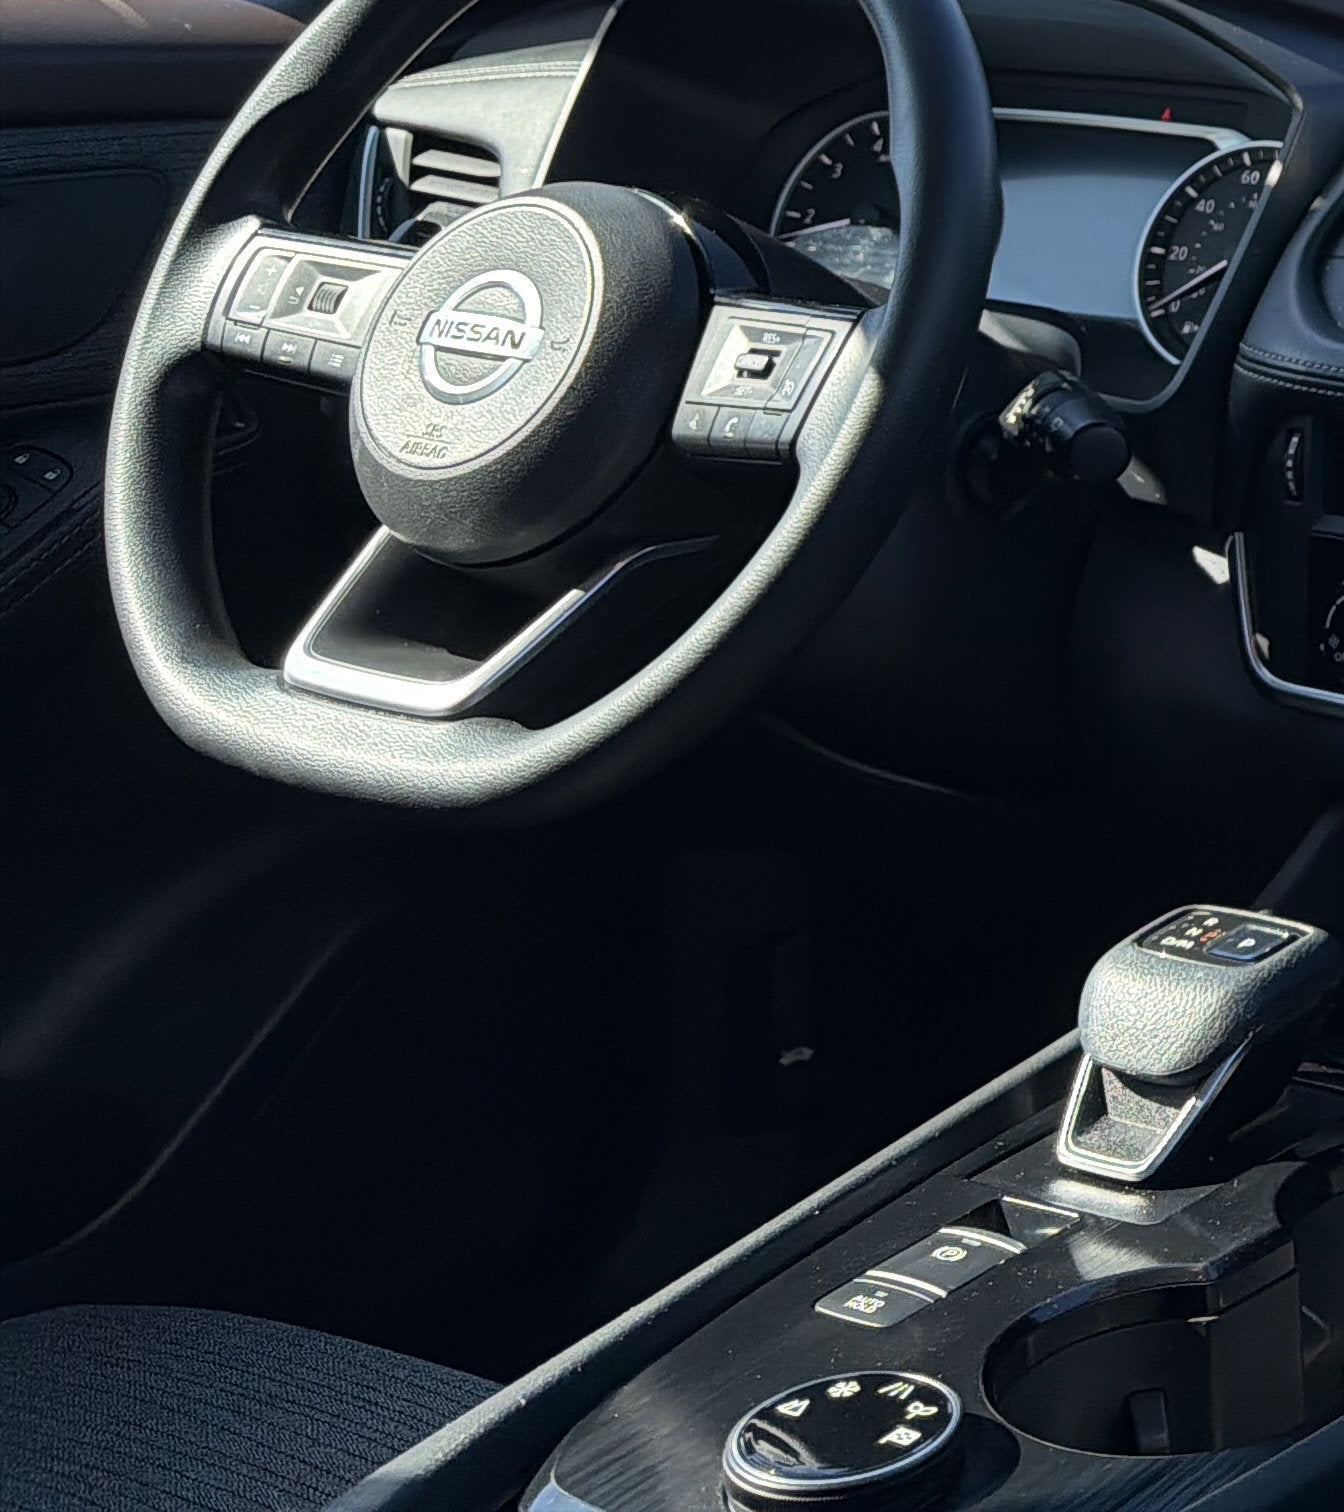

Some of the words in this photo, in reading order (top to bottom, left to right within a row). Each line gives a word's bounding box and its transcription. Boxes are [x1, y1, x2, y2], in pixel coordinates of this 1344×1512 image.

[873, 138, 884, 152] 4
[831, 162, 843, 179] 3
[1241, 170, 1260, 186] 60
[1195, 199, 1215, 214] 40
[804, 208, 815, 224] 2
[1169, 245, 1189, 261] 20
[1169, 299, 1181, 313] 0
[429, 318, 526, 350] NISSAN
[1184, 926, 1203, 937] N
[1237, 937, 1256, 949] P
[844, 1300, 878, 1314] HOLD
[856, 1294, 885, 1308] AUTO
